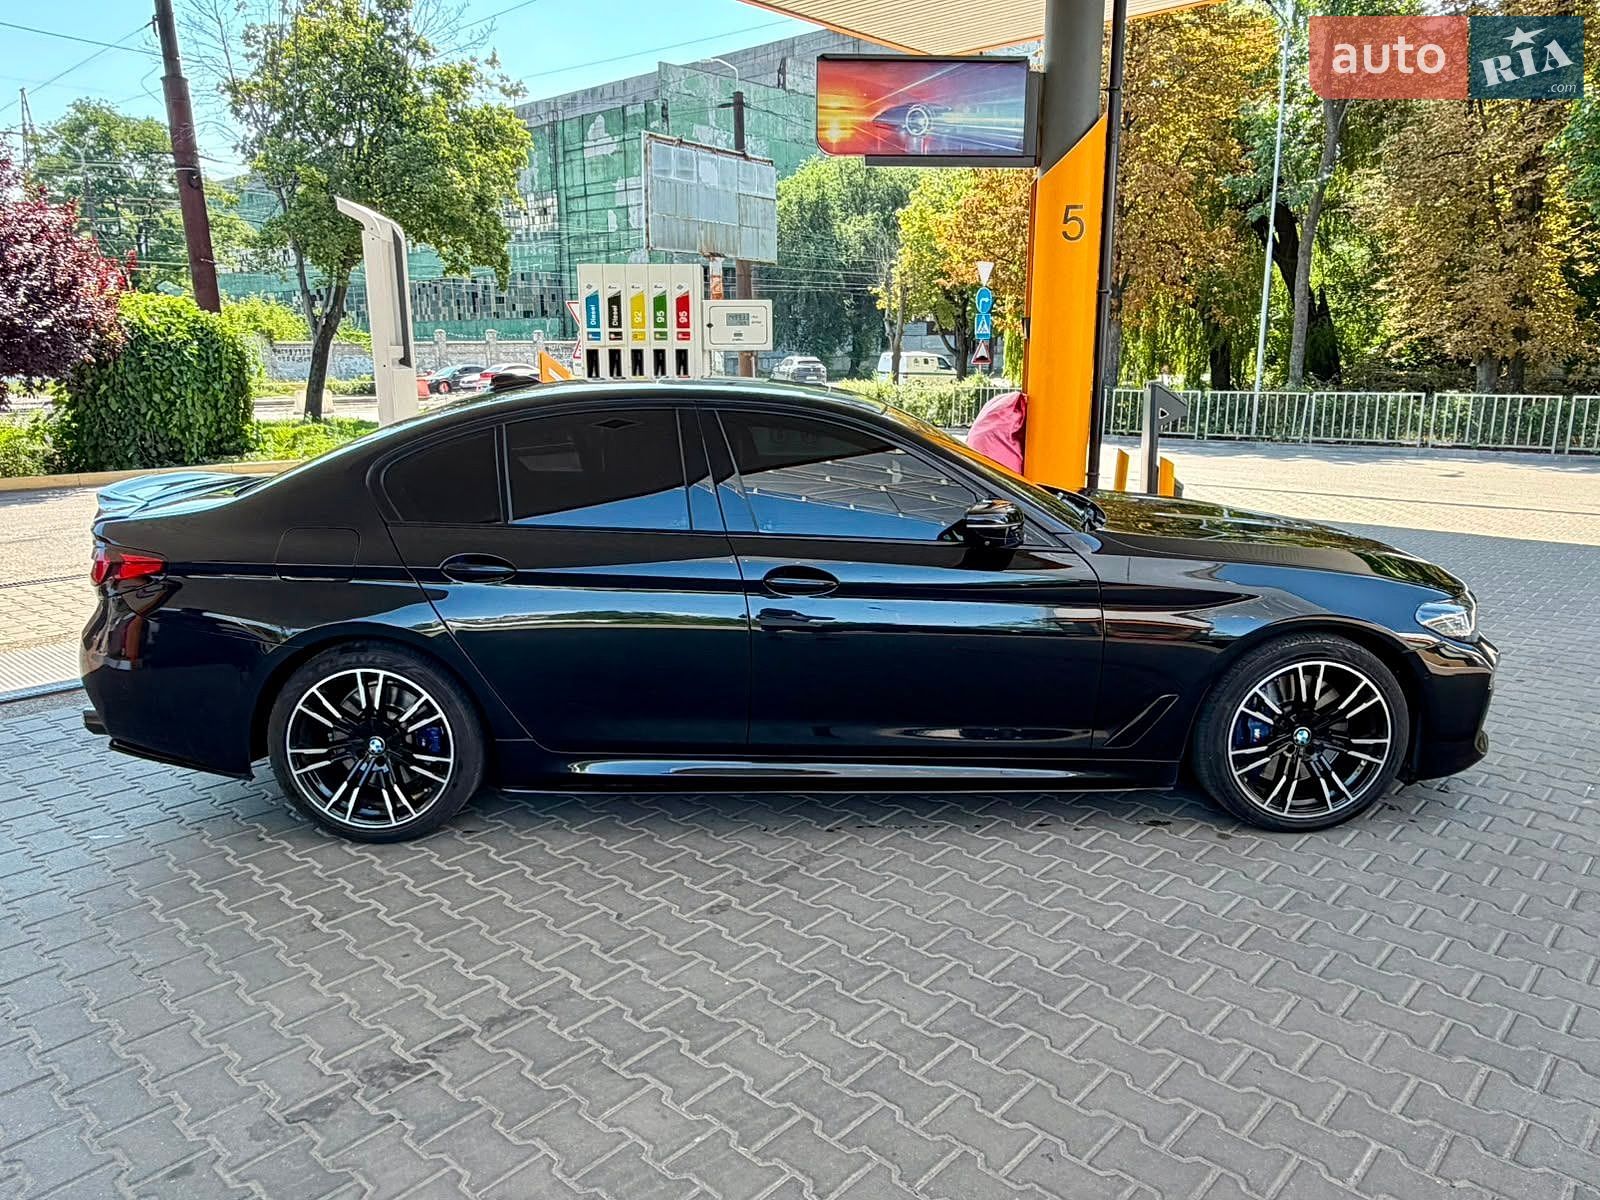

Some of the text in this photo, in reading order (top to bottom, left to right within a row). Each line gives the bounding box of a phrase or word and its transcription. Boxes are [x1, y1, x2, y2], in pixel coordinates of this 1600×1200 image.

[1062, 205, 1085, 241] 5
[634, 311, 642, 323] 92
[656, 310, 665, 323] 95
